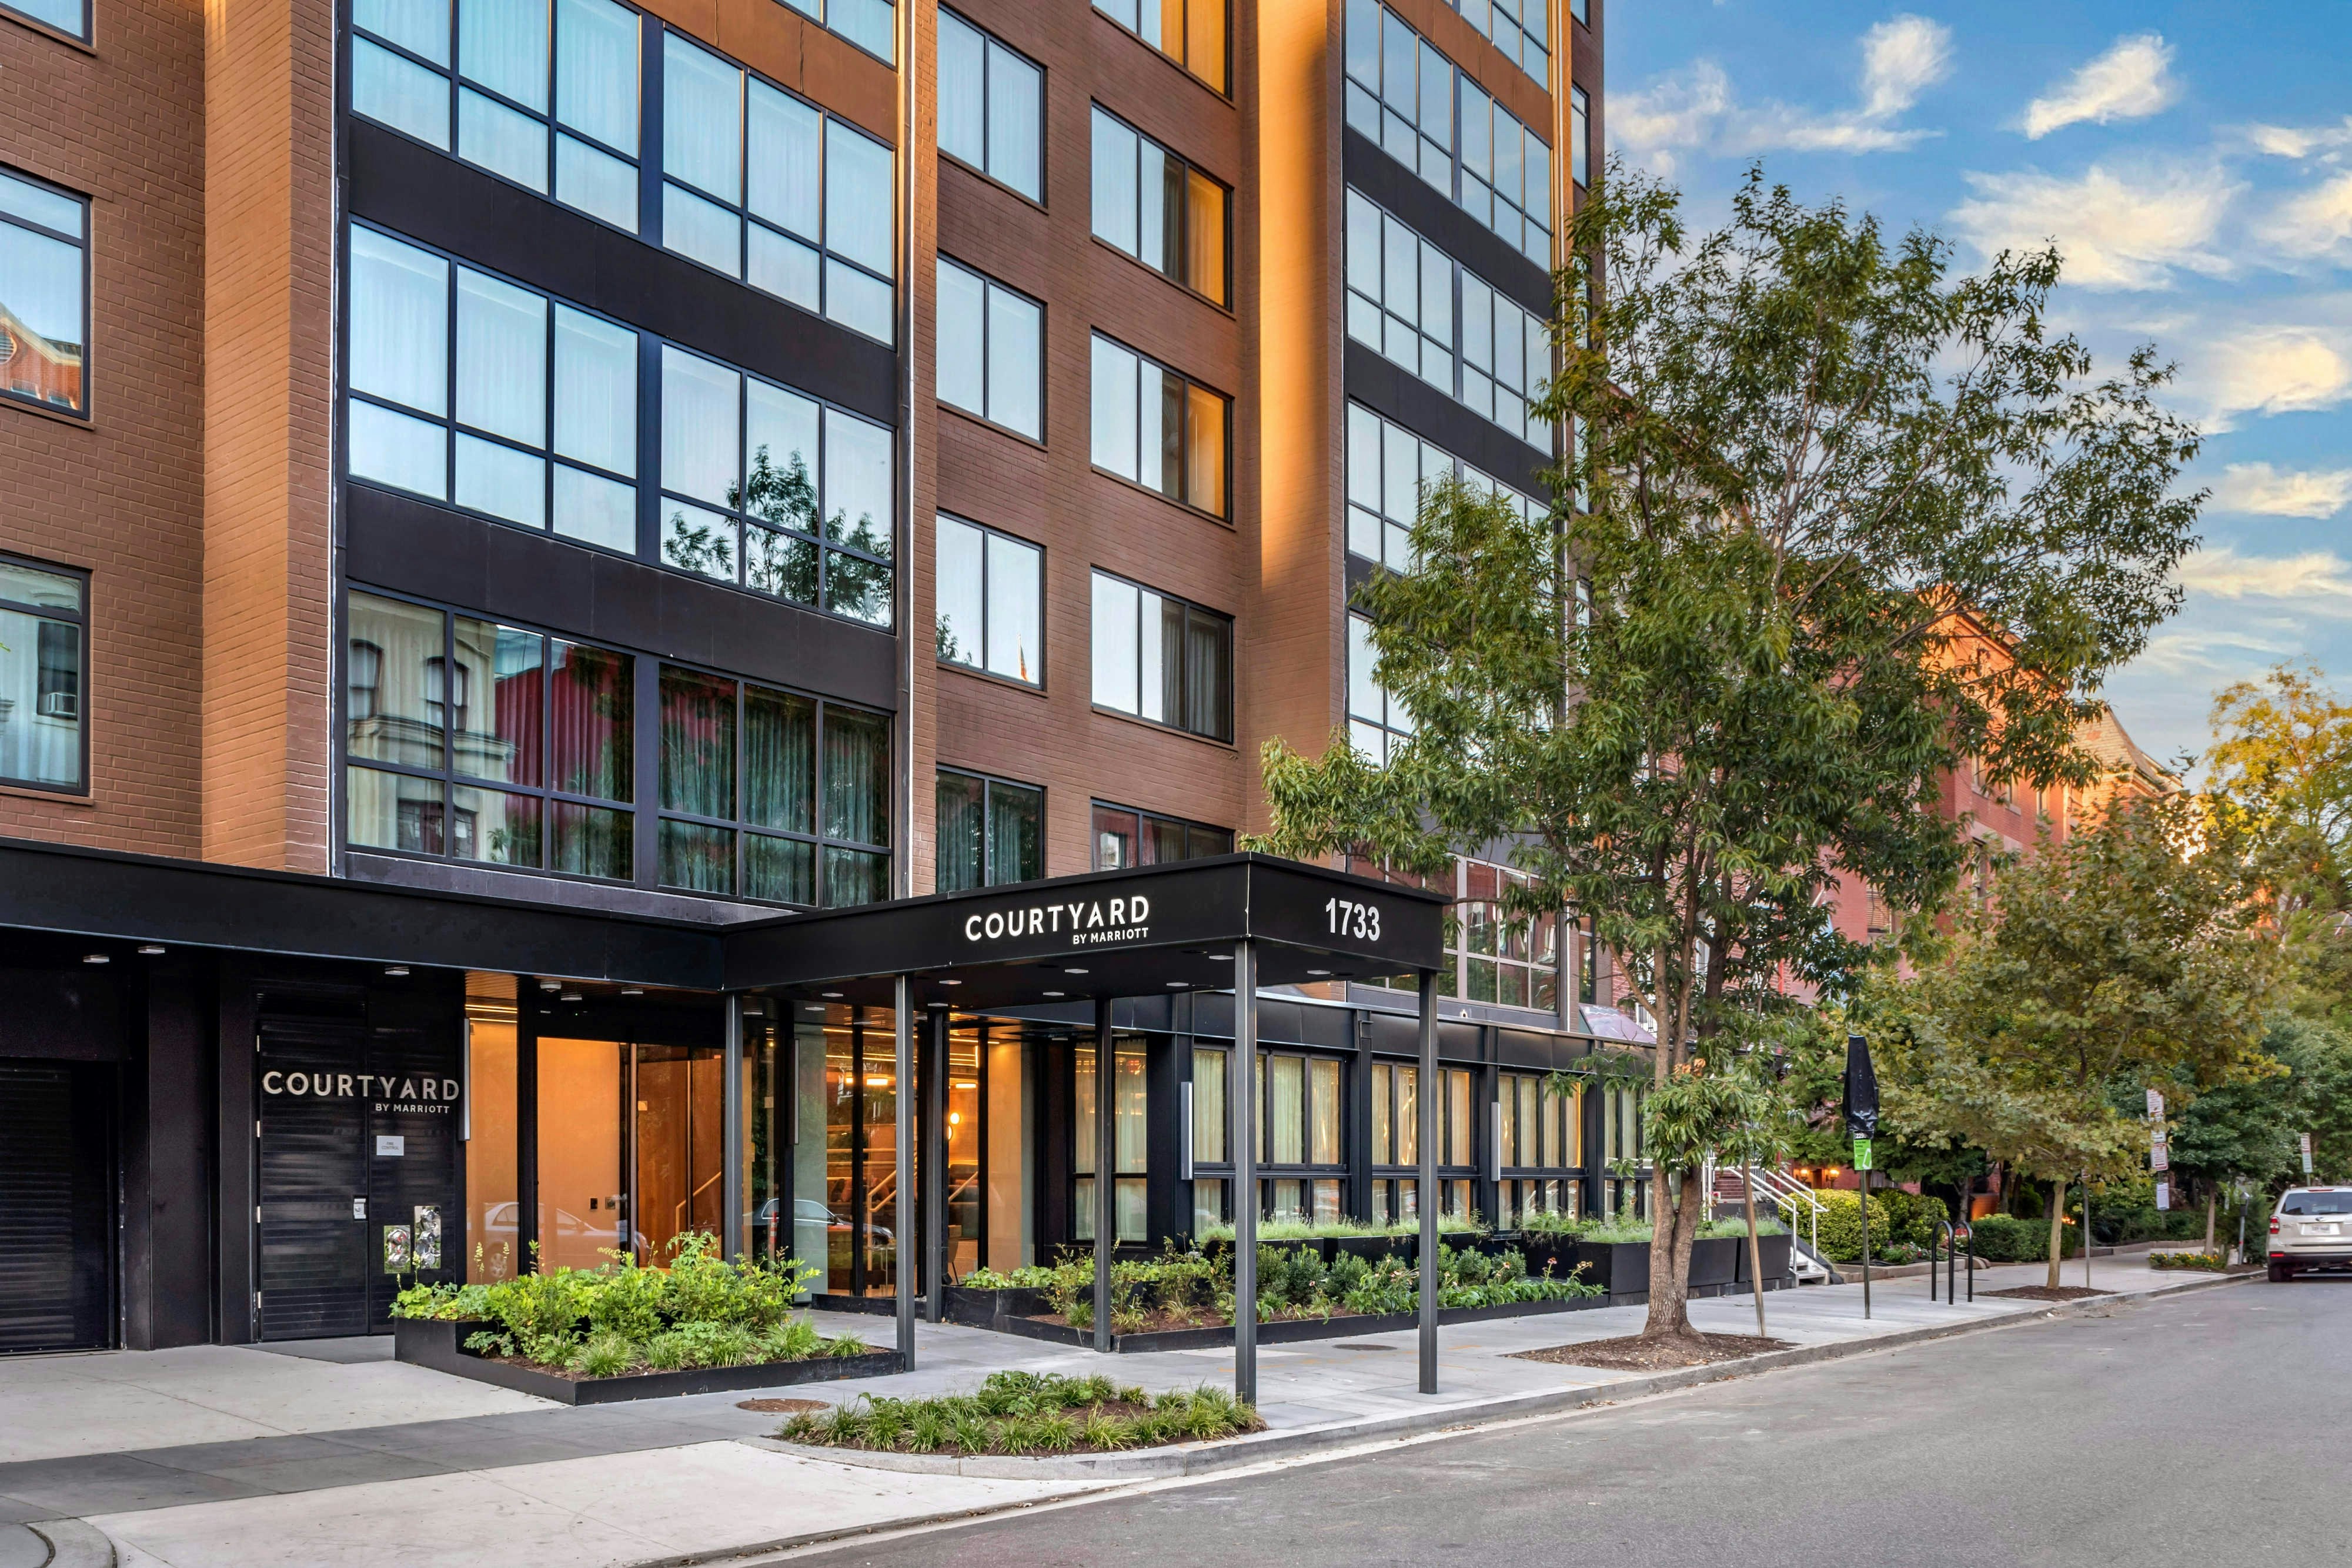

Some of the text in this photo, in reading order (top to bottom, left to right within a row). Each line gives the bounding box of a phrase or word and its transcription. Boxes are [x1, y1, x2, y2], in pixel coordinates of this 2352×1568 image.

[965, 895, 1150, 942] COURTYARD
[1325, 897, 1381, 942] 1733
[1073, 927, 1149, 945] BY MARRIOTT
[262, 1071, 459, 1101] COURTYARD
[375, 1103, 450, 1114] BY MARRIOTT
